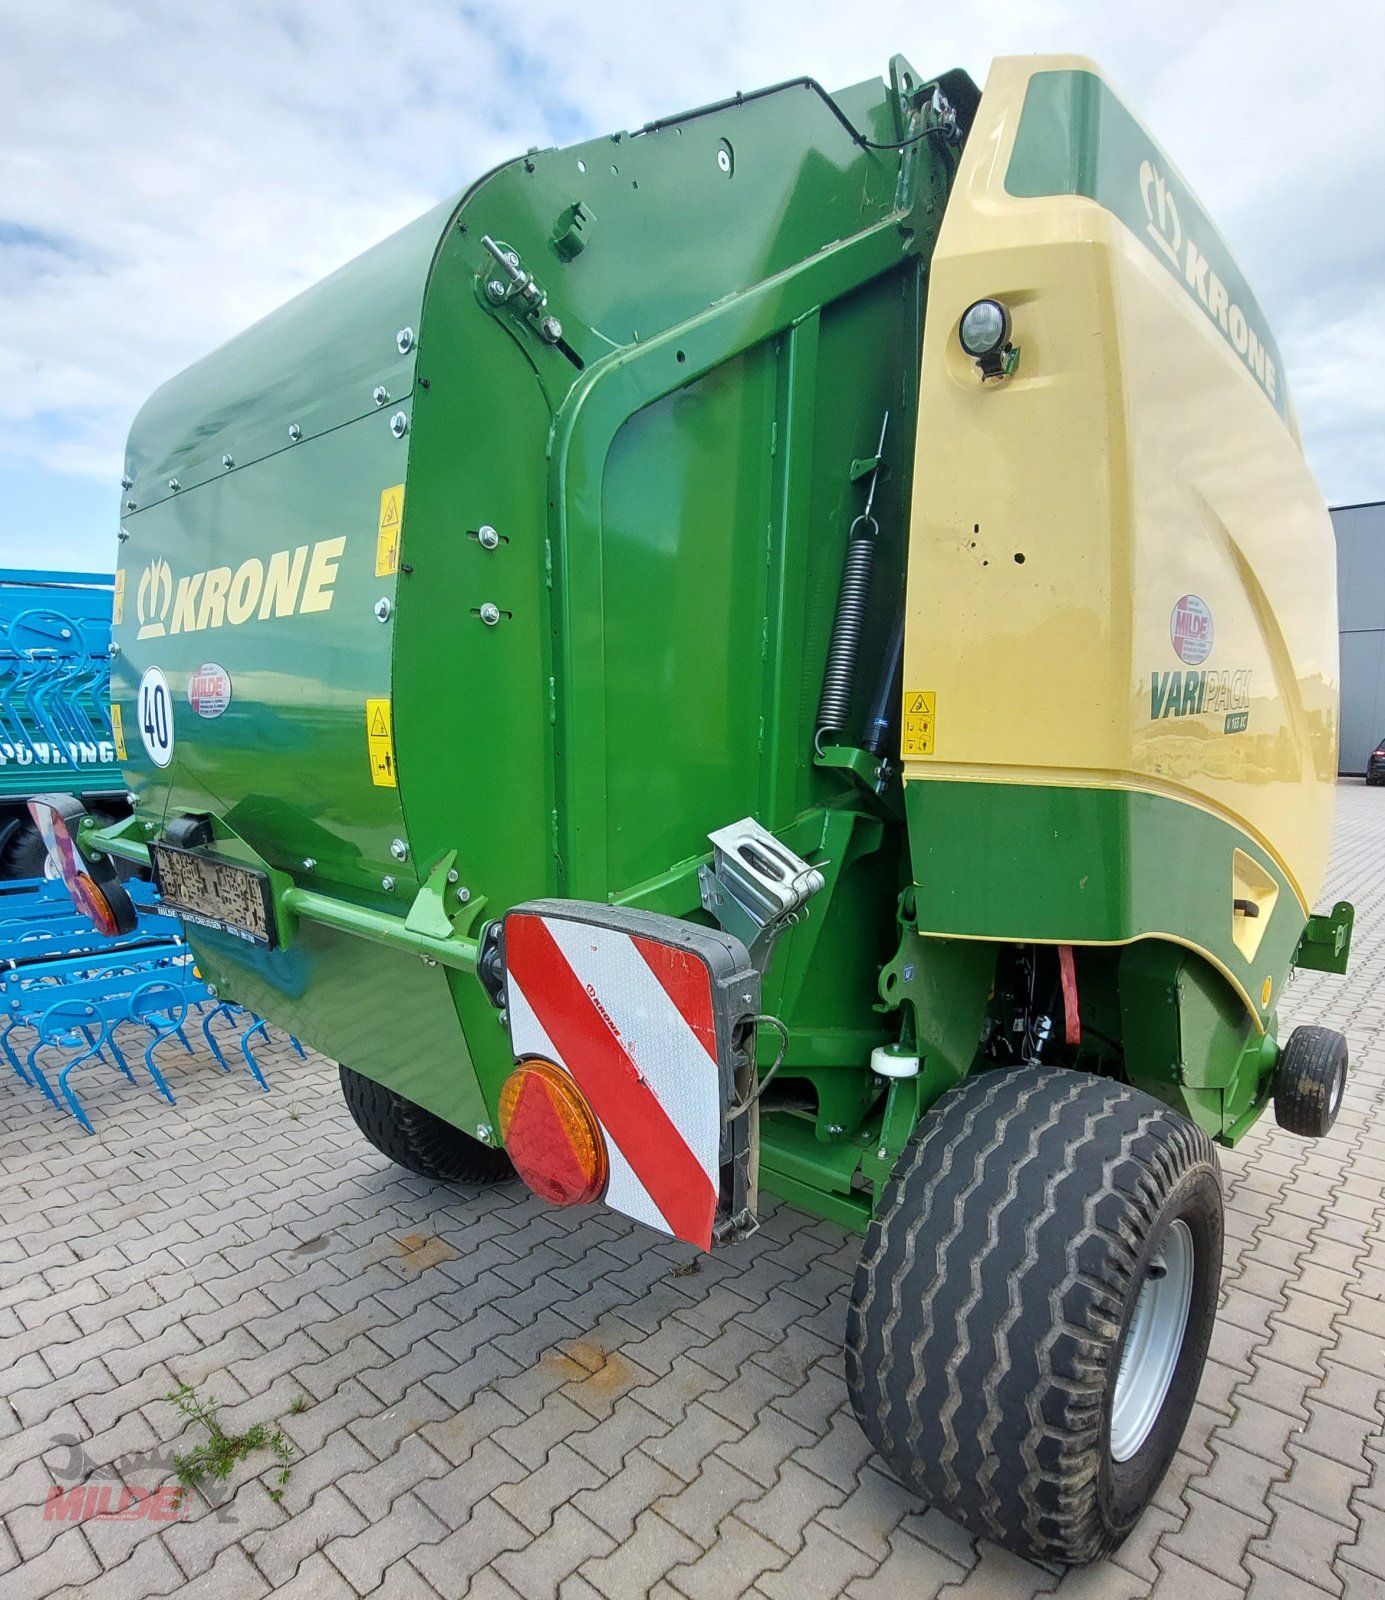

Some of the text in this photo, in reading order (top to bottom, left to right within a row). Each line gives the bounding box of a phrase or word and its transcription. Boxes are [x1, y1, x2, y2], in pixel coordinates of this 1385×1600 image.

[1185, 239, 1275, 400] KRONE
[169, 535, 347, 635] KRONE
[1175, 610, 1208, 640] MILDE
[191, 677, 224, 697] MILDE
[144, 684, 168, 750] 40
[593, 998, 621, 1037] KRONE
